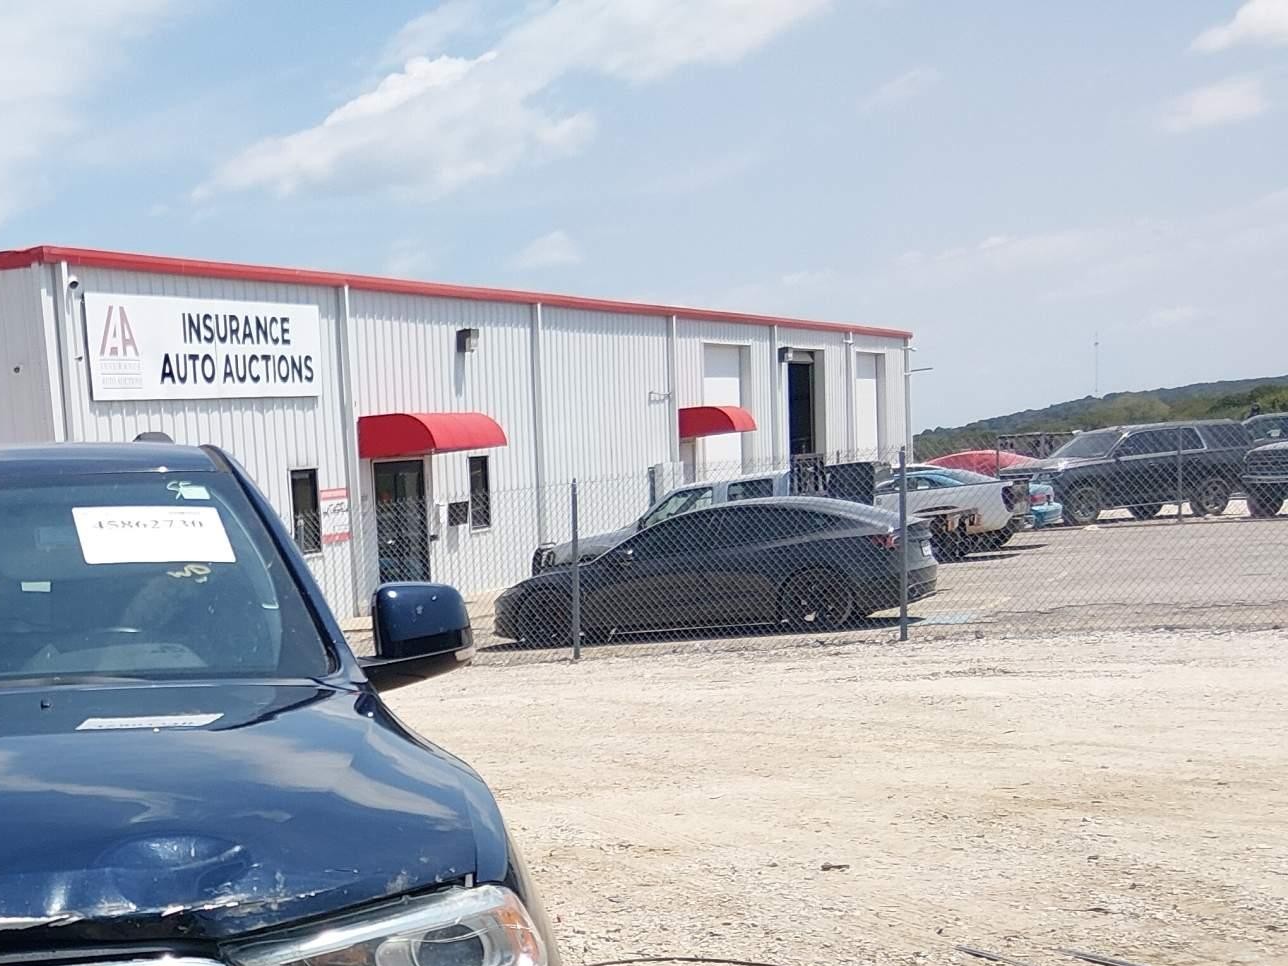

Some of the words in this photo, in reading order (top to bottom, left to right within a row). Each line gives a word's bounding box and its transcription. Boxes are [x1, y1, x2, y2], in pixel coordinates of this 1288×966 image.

[182, 312, 291, 345] INSURANCE
[160, 353, 216, 385] AUTO
[223, 354, 314, 384] AUCTIONS
